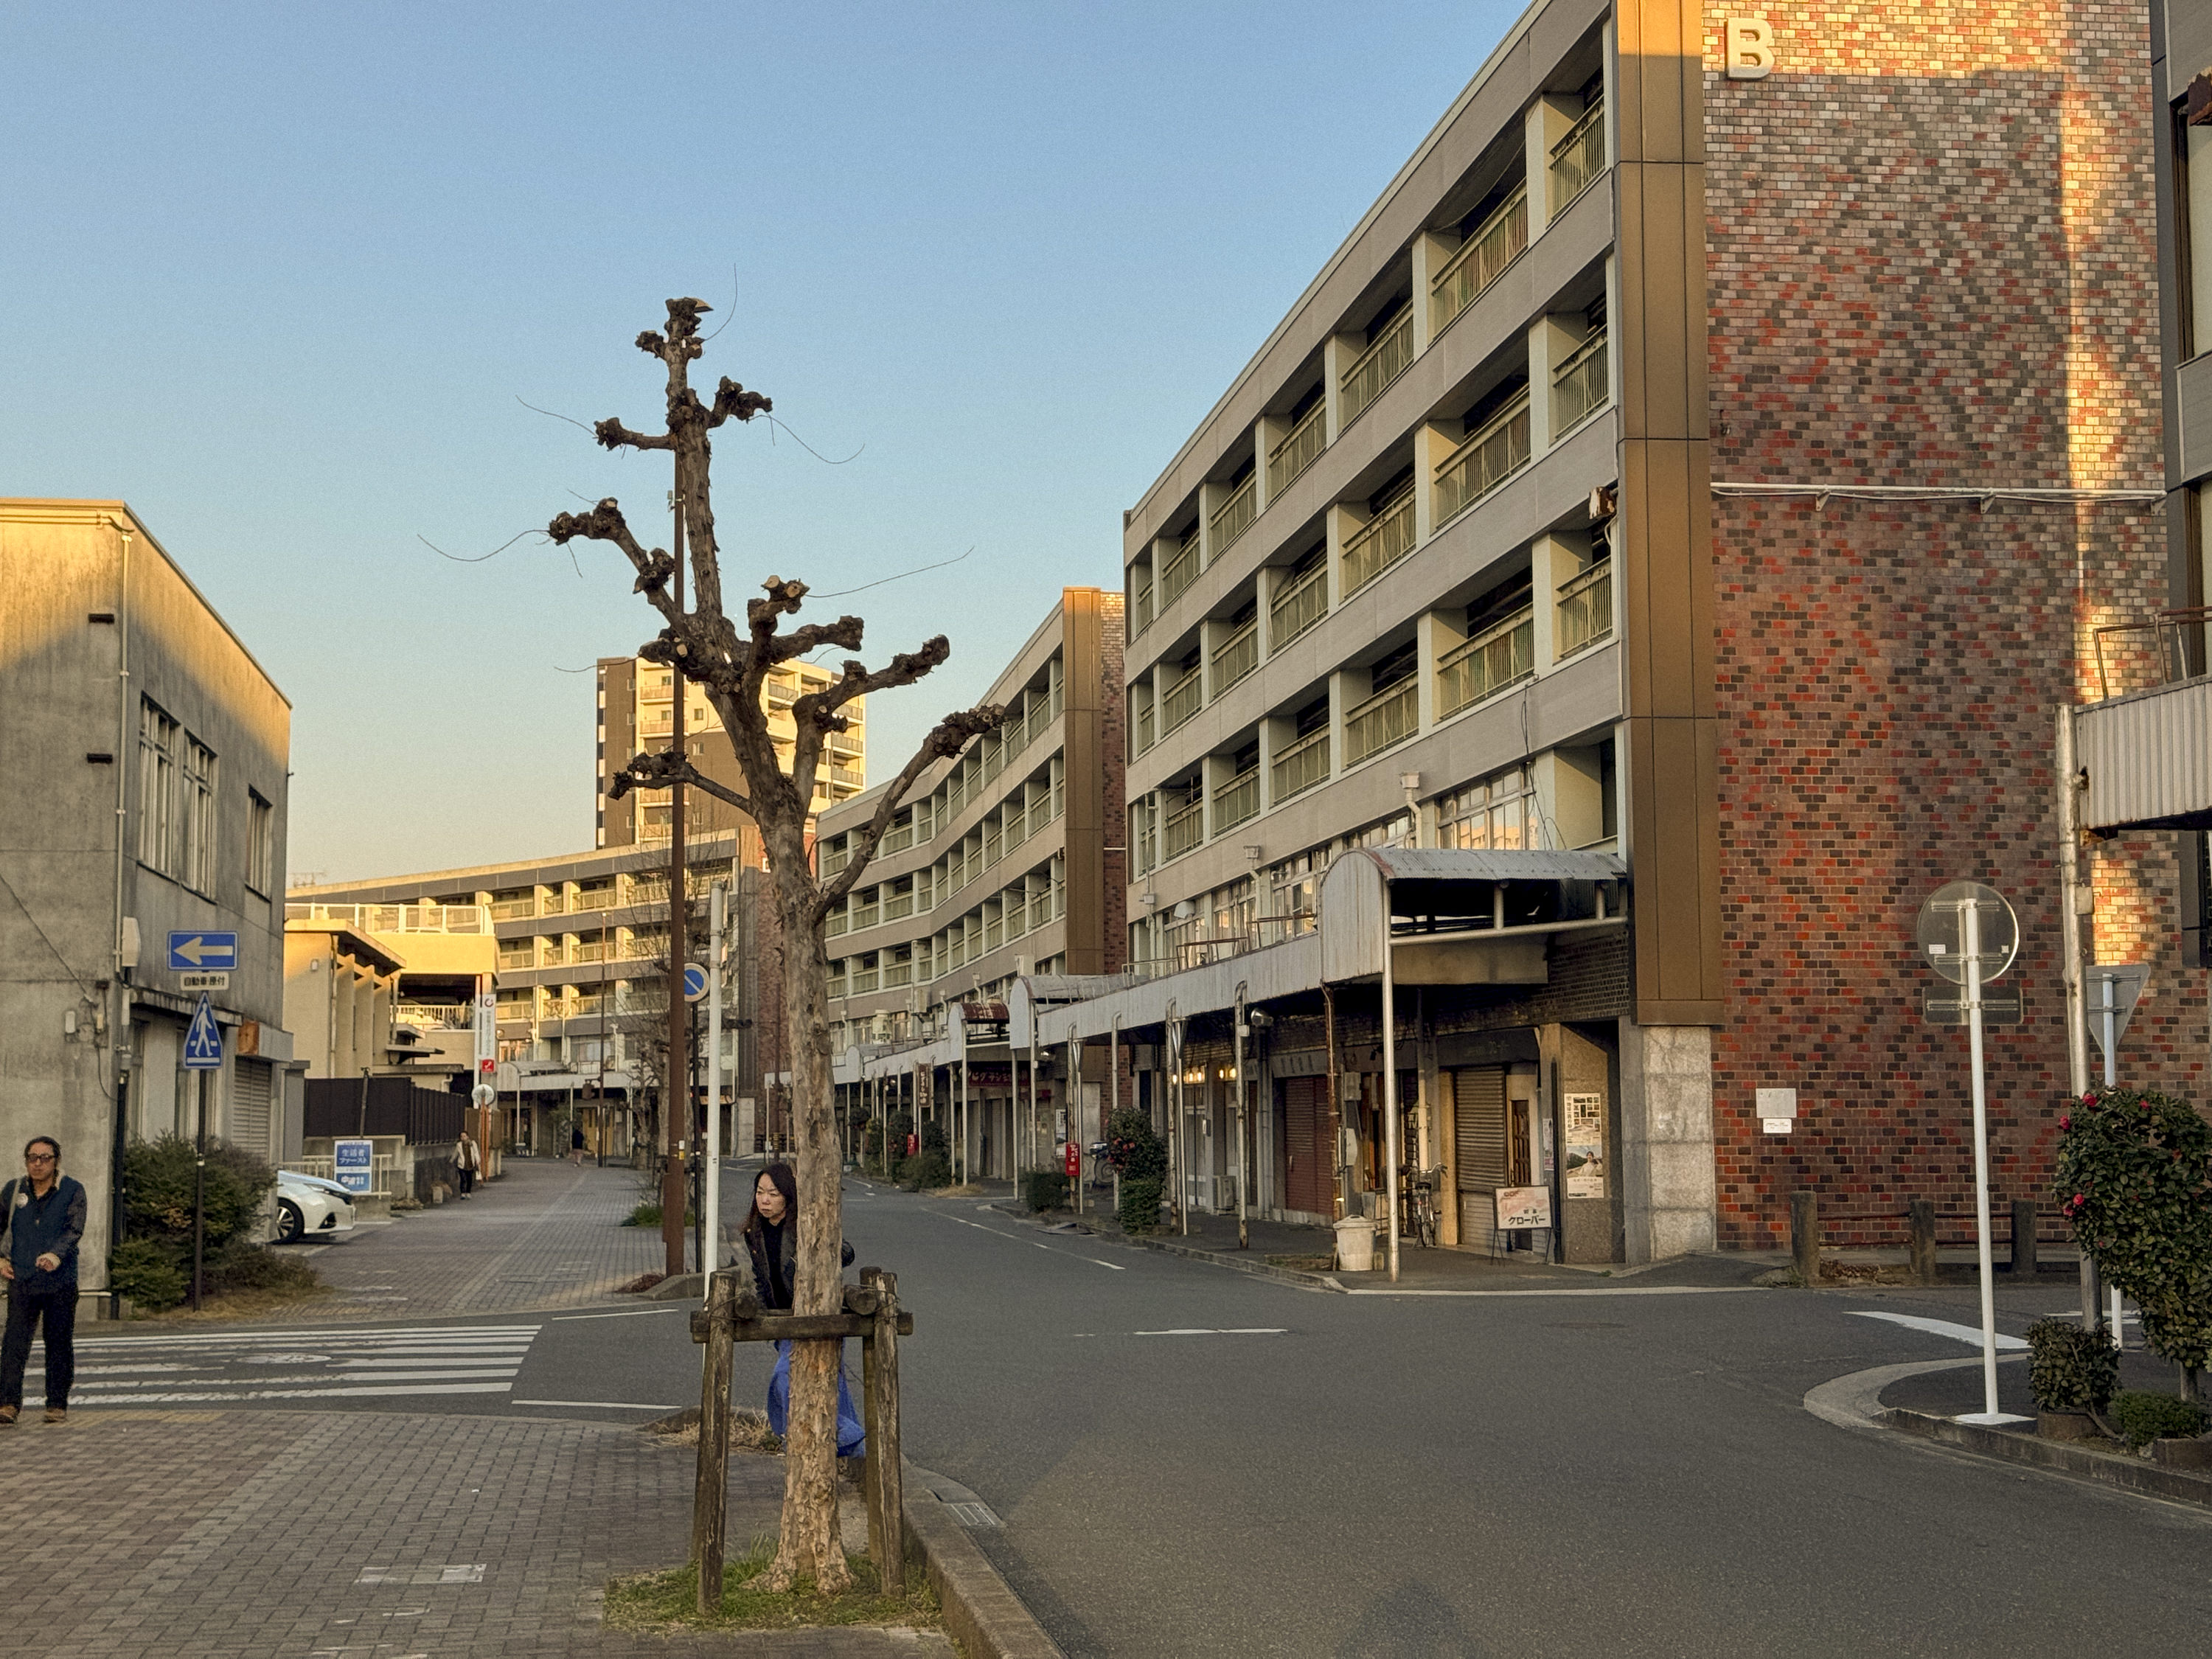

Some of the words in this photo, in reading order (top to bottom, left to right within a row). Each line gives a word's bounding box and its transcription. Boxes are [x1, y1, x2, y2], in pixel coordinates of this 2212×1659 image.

[1728, 18, 1775, 77] B
[1508, 1214, 1546, 1225] クローバー
